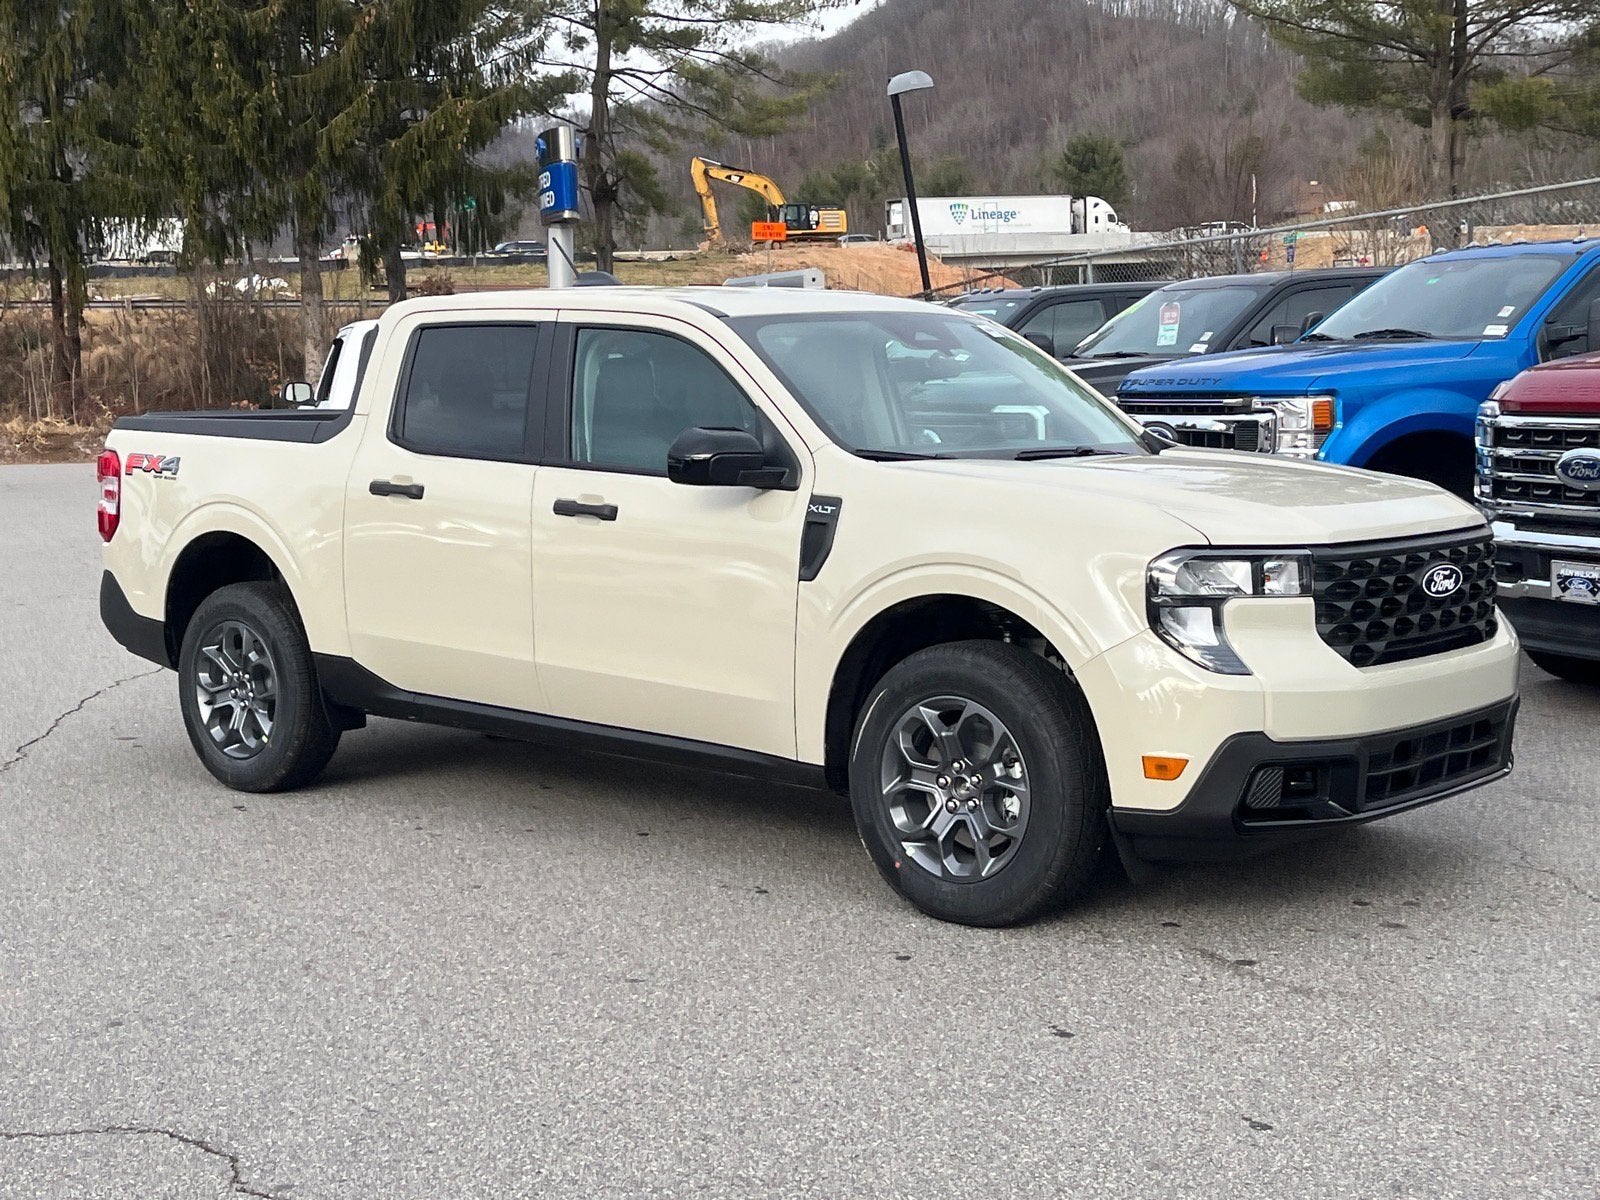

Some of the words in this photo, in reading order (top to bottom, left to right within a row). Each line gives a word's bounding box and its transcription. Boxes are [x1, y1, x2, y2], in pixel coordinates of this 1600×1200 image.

[970, 207, 1017, 223] Lineage
[1131, 378, 1175, 386] SUPER
[1177, 378, 1223, 386] DUTY
[125, 453, 181, 476] FX4
[1568, 459, 1600, 478] Ford
[807, 504, 837, 514] XLT
[1430, 569, 1456, 593] Ford
